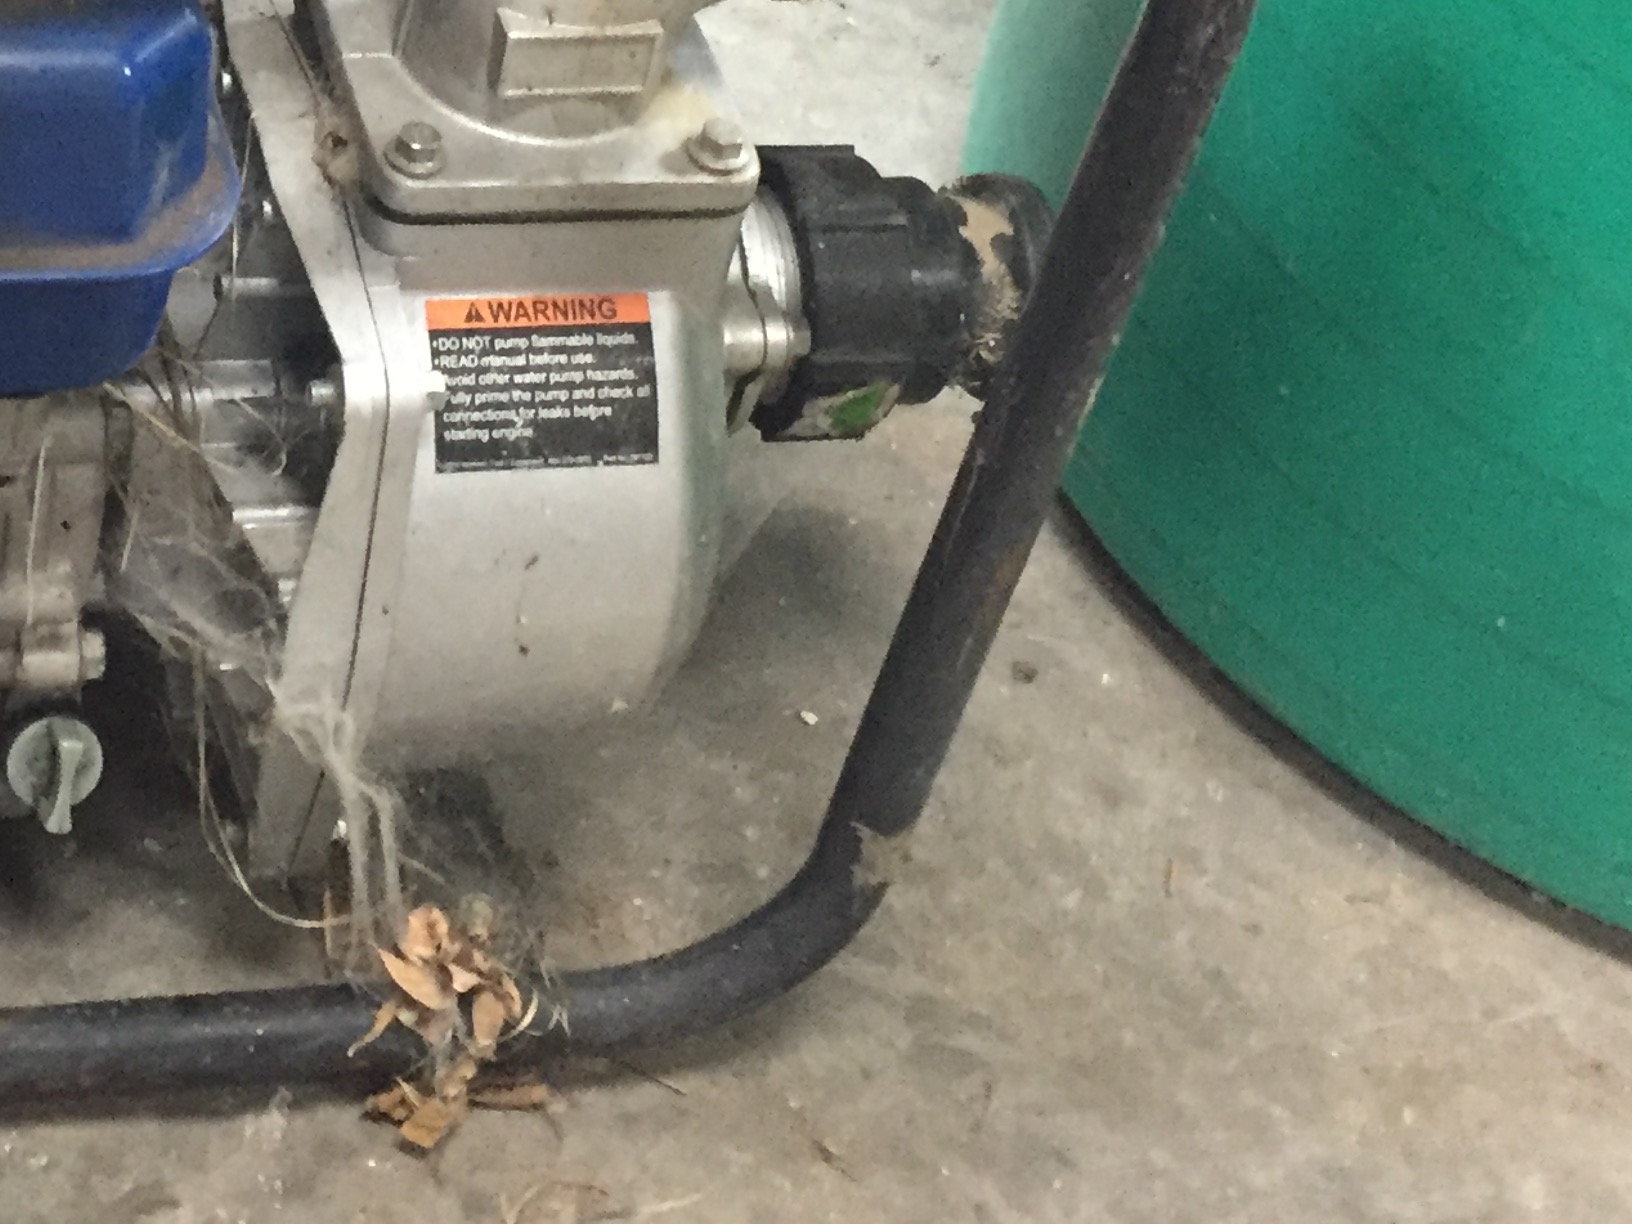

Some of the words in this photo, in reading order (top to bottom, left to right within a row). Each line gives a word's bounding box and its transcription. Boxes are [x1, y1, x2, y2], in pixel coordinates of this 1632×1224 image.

[488, 297, 617, 323] WARNING
[438, 337, 460, 351] DO
[462, 336, 491, 350] NOT
[494, 337, 529, 351] pump
[439, 354, 478, 368] READ
[480, 353, 527, 367] manual
[528, 352, 568, 365] before
[549, 371, 584, 385] pump
[534, 389, 570, 402] pump
[572, 387, 596, 399] and
